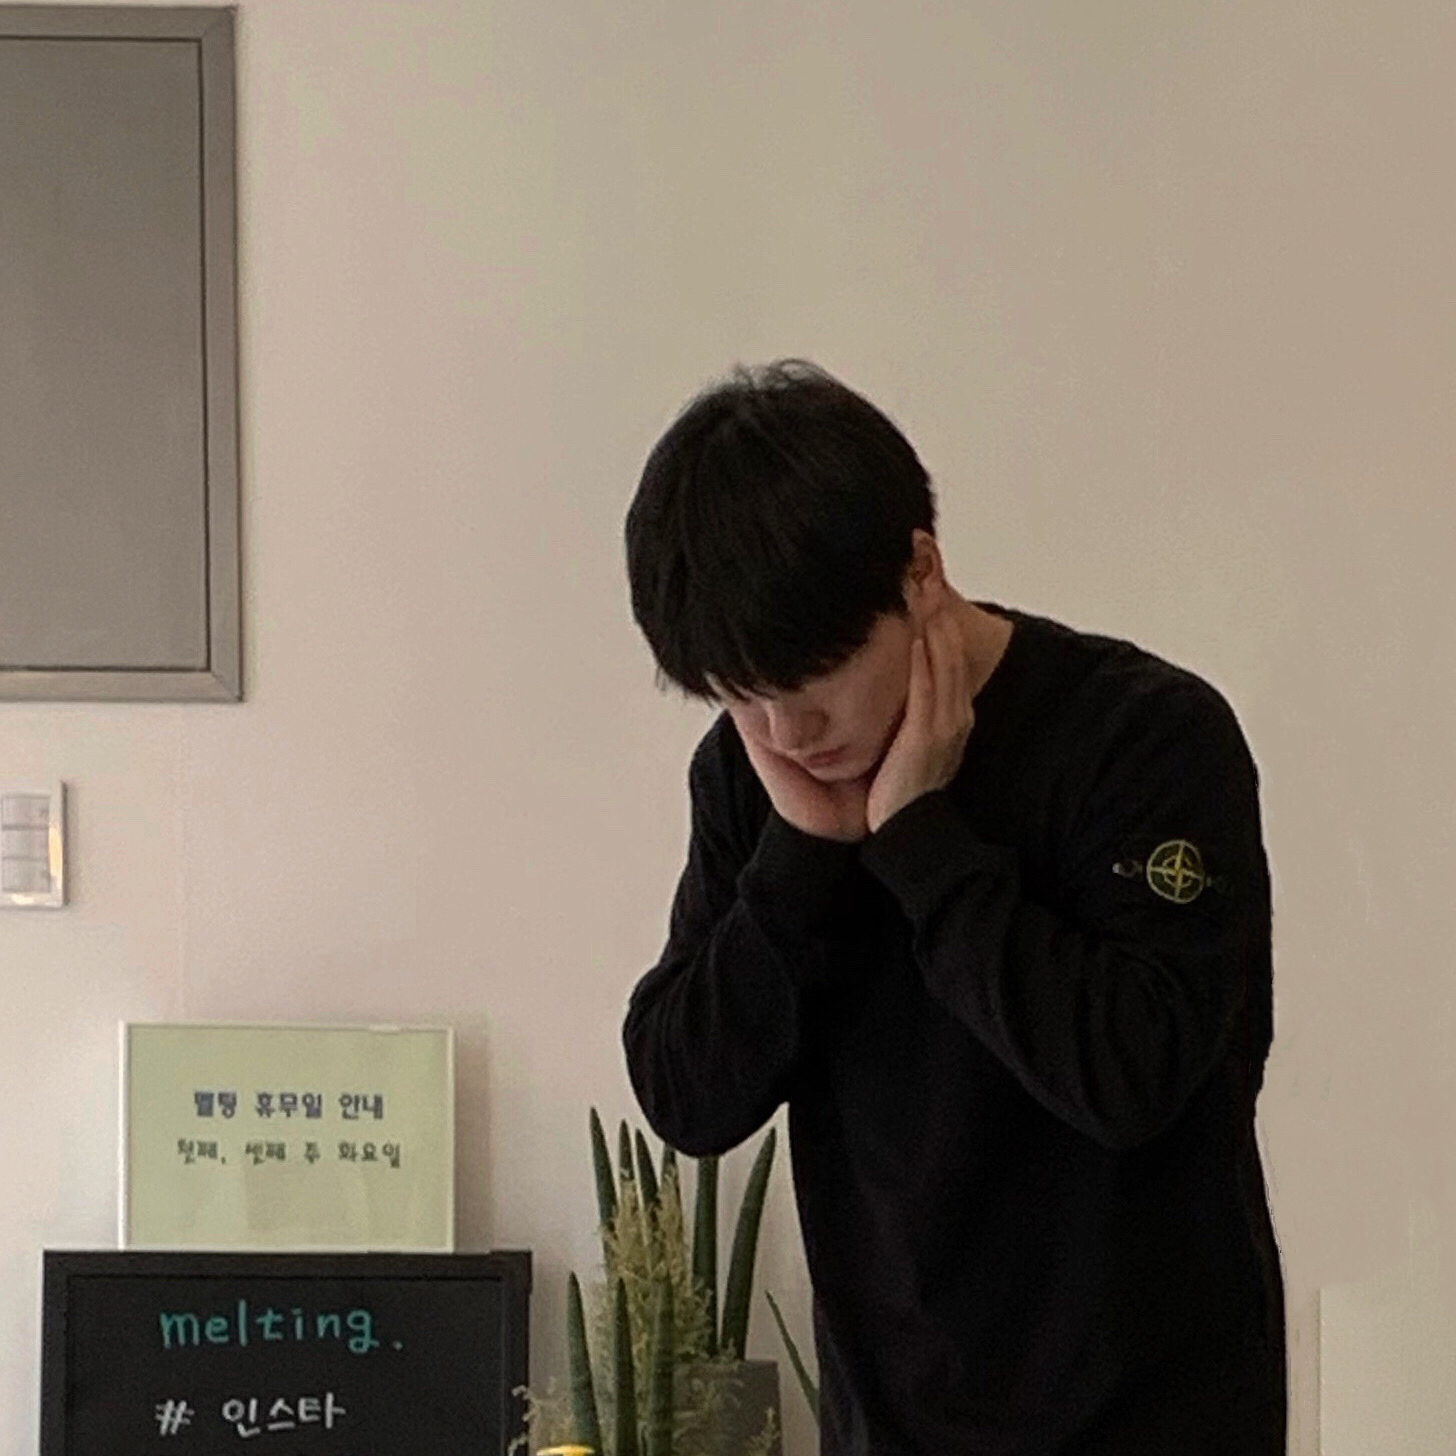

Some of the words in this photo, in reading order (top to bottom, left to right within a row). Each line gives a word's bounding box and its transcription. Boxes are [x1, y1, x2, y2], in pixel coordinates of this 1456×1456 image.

[256, 1091, 323, 1119] 휴무일
[338, 1093, 384, 1120] 안내
[338, 1140, 401, 1169] 화요일
[222, 1392, 347, 1438] 인스타
